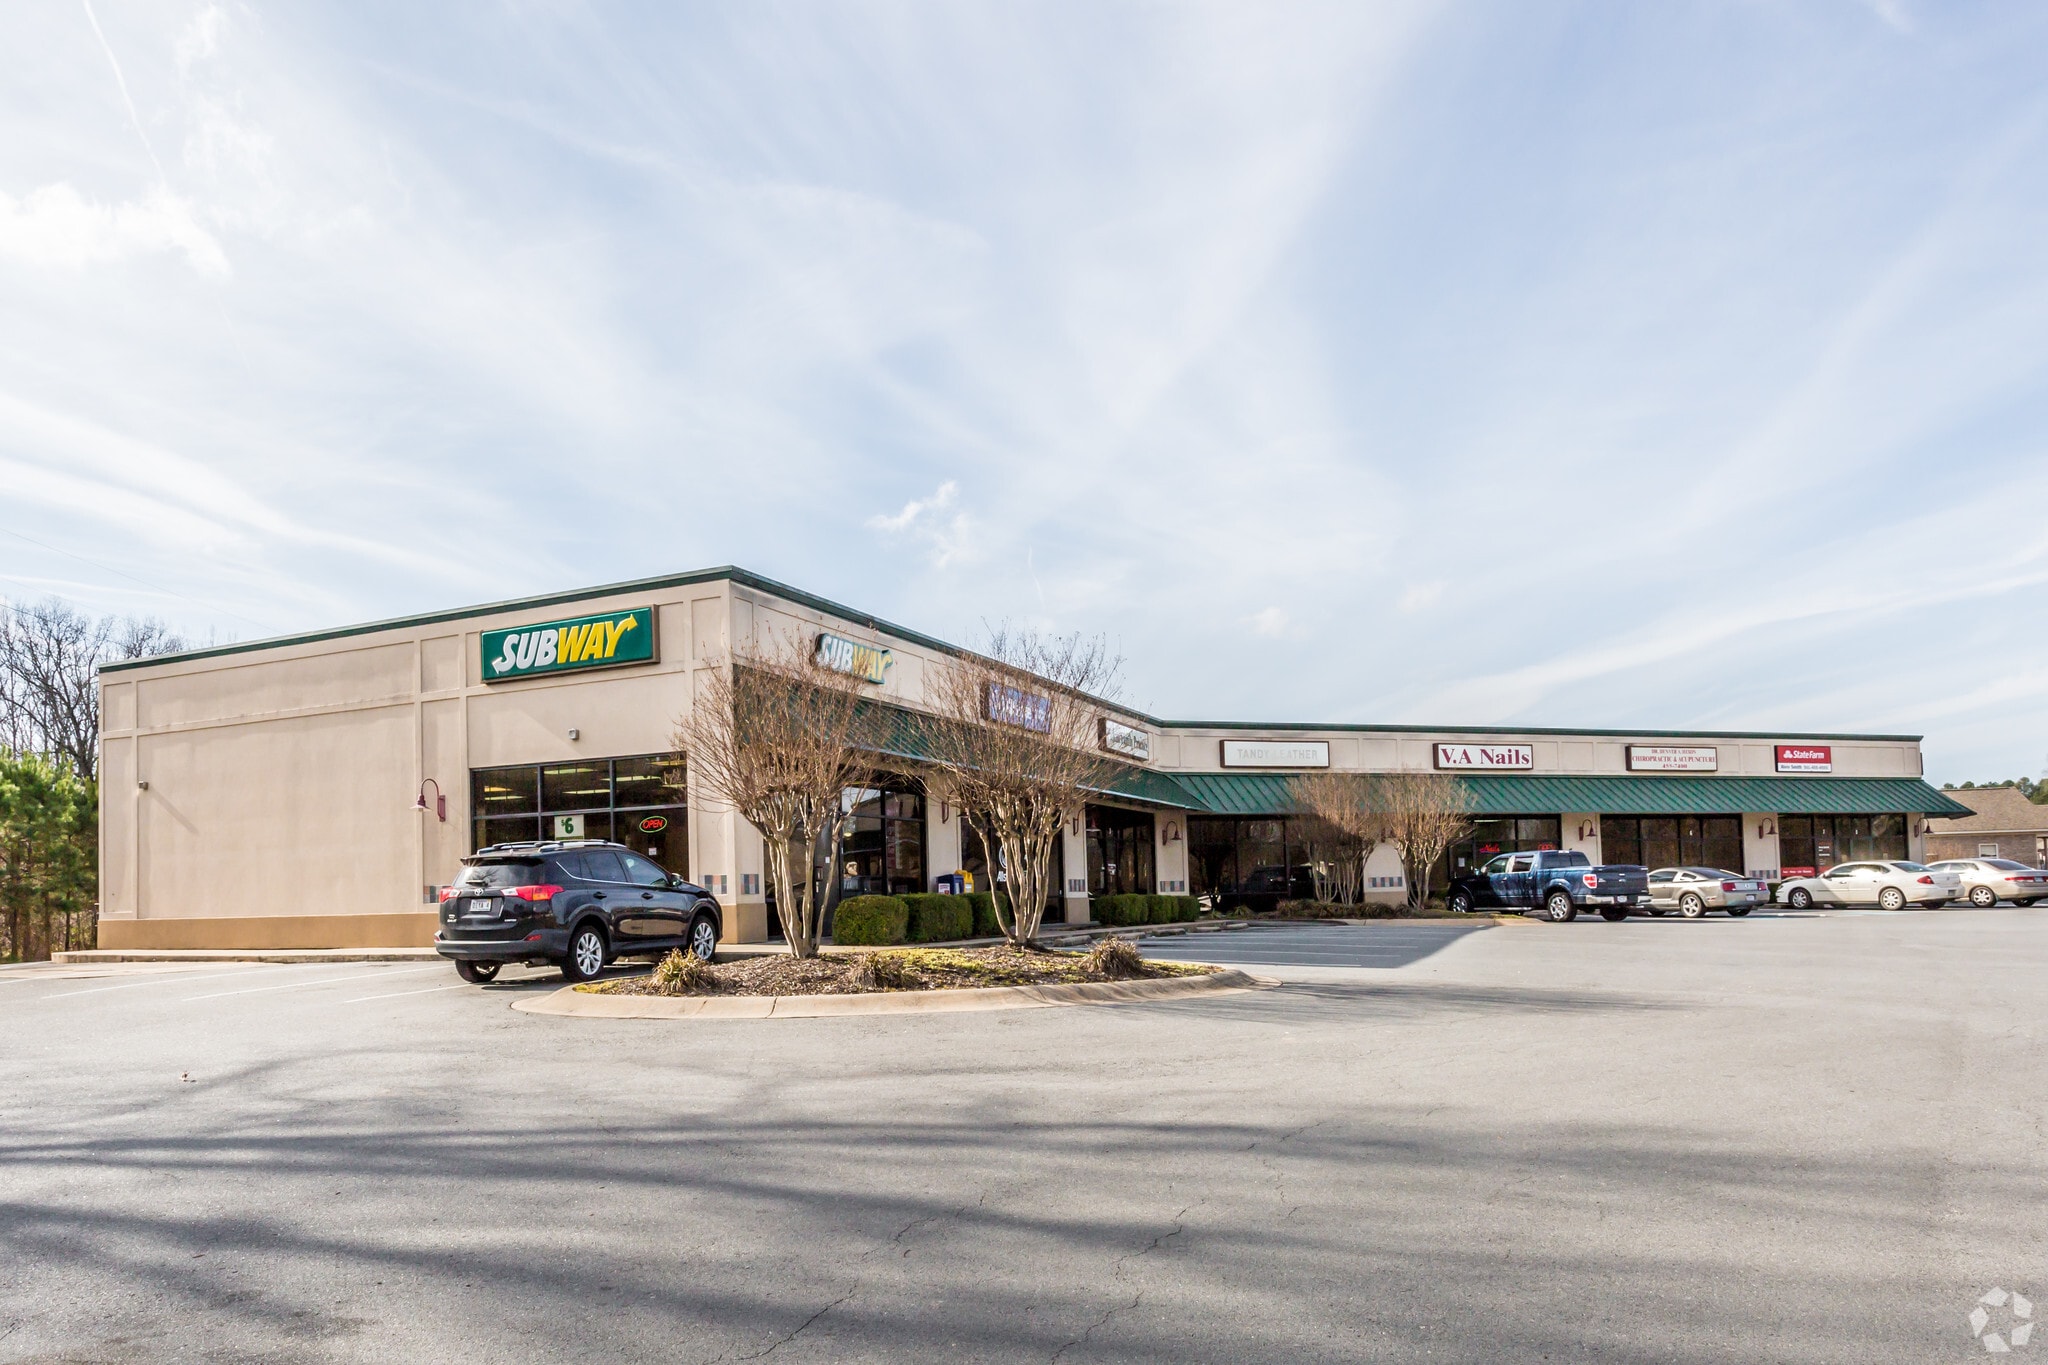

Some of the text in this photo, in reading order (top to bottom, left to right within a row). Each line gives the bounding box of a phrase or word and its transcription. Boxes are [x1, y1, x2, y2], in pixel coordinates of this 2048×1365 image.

[492, 614, 638, 674] SUBWAY
[816, 635, 893, 680] SUBWAY
[1237, 748, 1269, 760] TANDY
[1441, 748, 1530, 765] V.A Nails
[642, 819, 663, 829] OPEN
